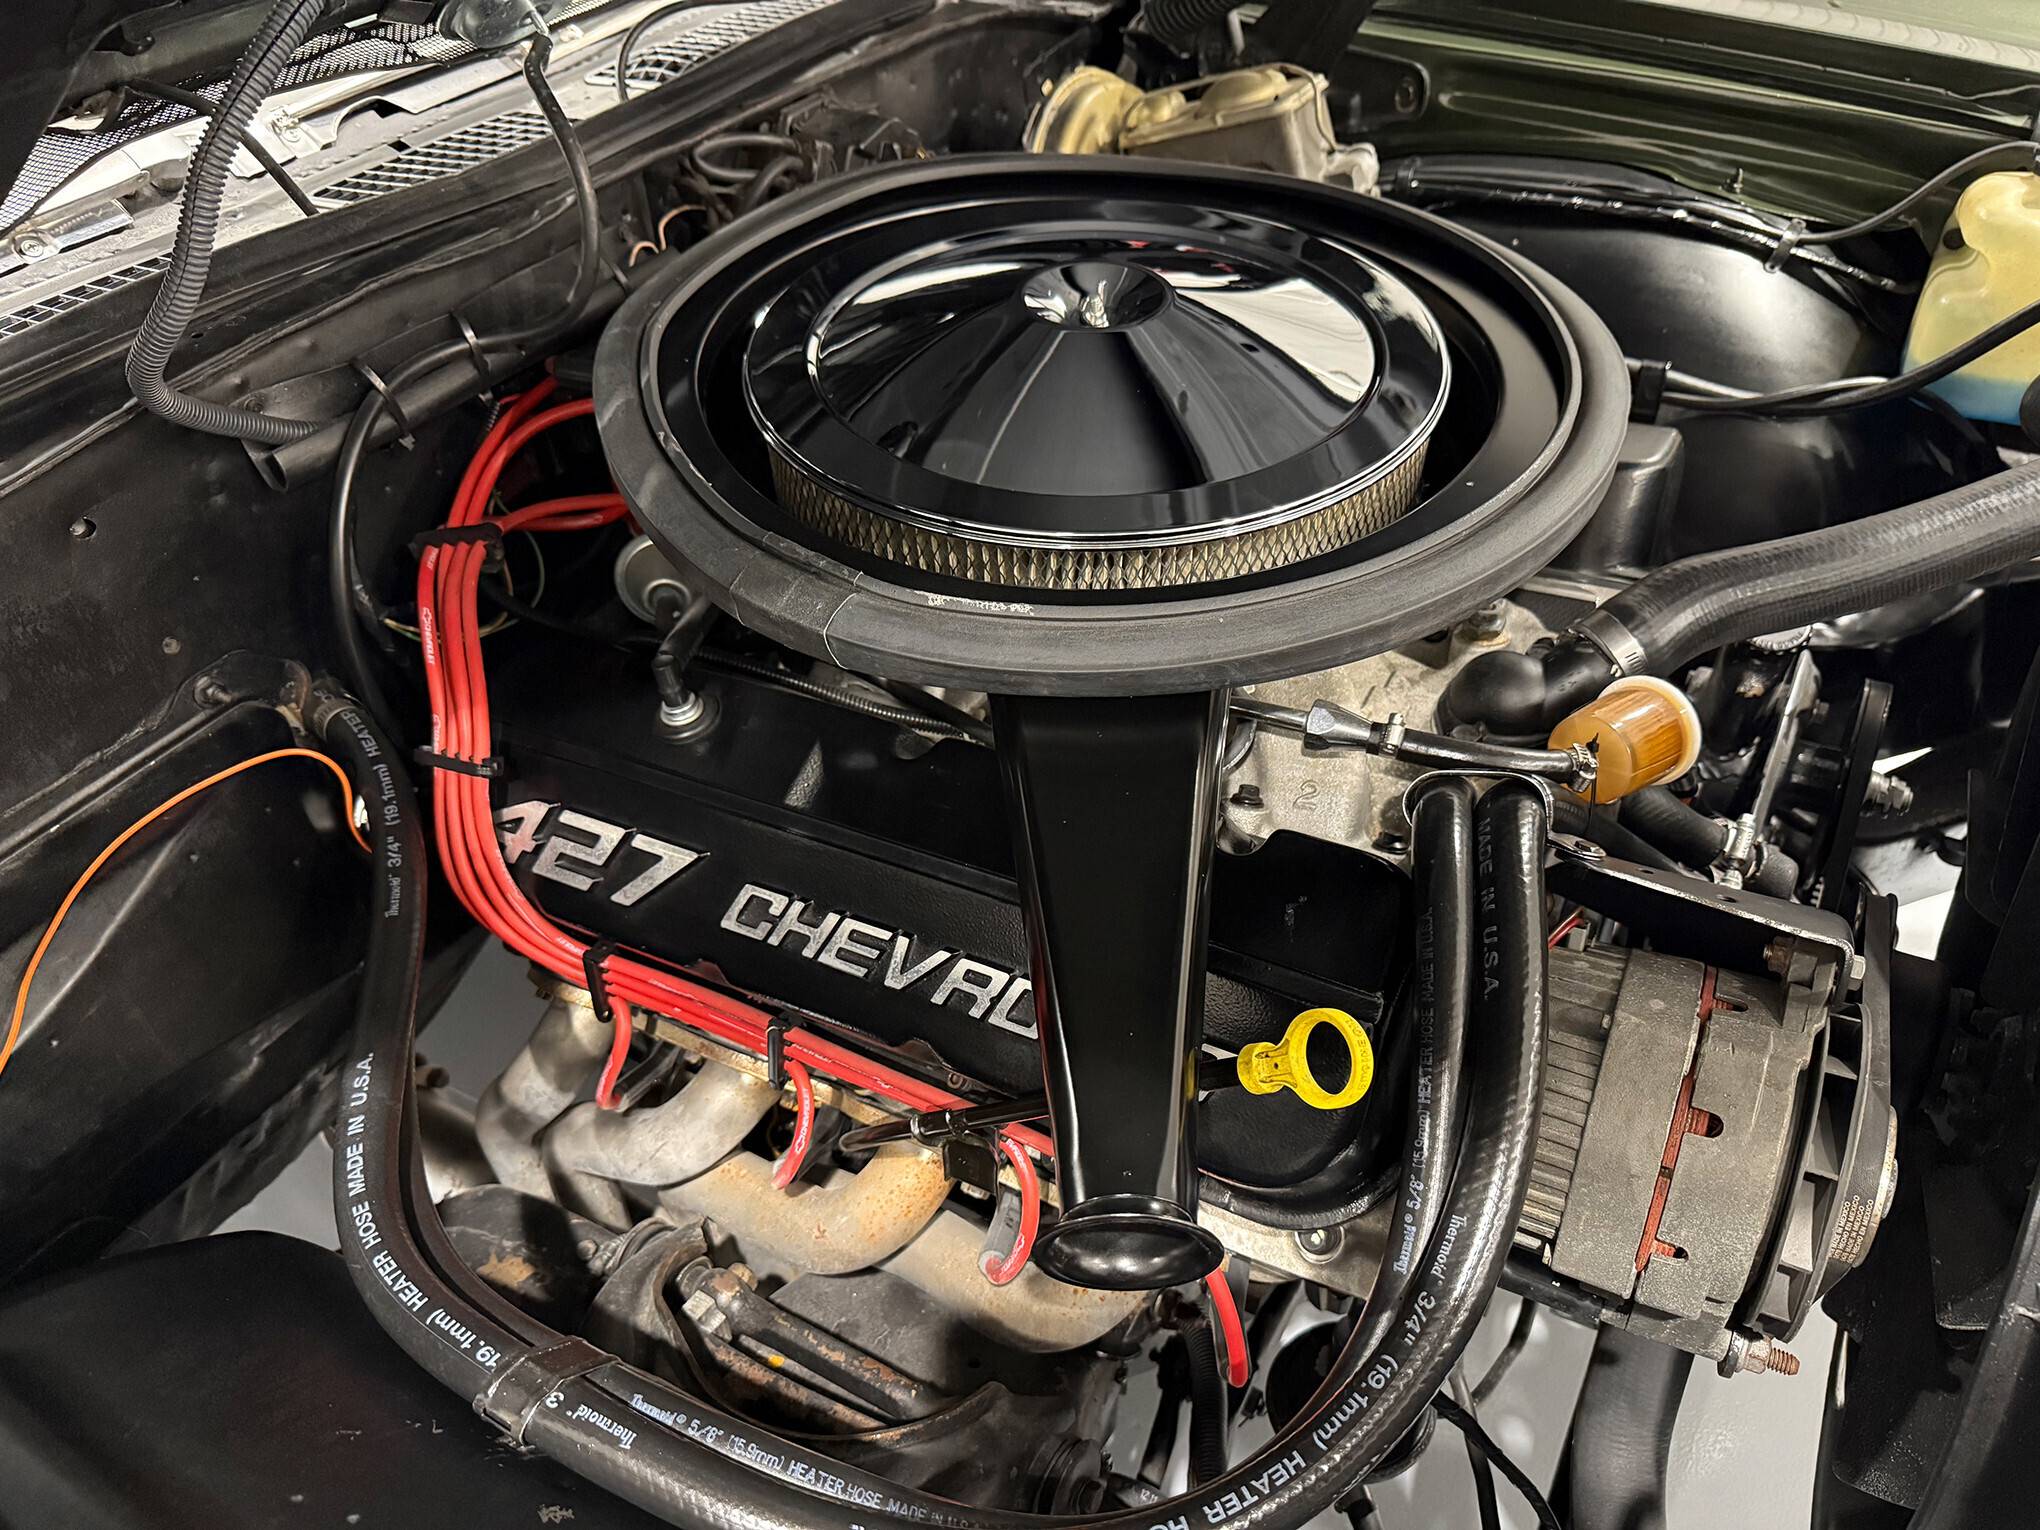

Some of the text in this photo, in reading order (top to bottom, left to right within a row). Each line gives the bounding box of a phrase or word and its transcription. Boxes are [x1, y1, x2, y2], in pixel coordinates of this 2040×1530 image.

[341, 710, 382, 758] HEATER
[372, 763, 401, 826] (19.1mm)
[386, 836, 402, 868] 3/4"
[494, 800, 706, 907] 427
[1420, 1007, 1434, 1044] HOSE
[351, 1052, 374, 1108] U.S.A.
[1417, 1046, 1433, 1104] HEATER
[347, 1114, 365, 1136] IN
[347, 1142, 366, 1198] MADE
[1408, 1175, 1424, 1211] 5/8"
[352, 1201, 382, 1250] HOSE
[1848, 1195, 1860, 1222] MEXICO
[1853, 1205, 1865, 1231] MEXICO
[1862, 1199, 1874, 1226] MEXICO
[1431, 1214, 1467, 1276] Thermoid
[372, 1250, 429, 1312] HEATER
[1404, 1291, 1436, 1346] 3/4"
[574, 1403, 638, 1450] Thermoid
[687, 1419, 724, 1444] 5/8"
[787, 1459, 845, 1498] HEATER
[846, 1483, 883, 1509] HOSE
[887, 1498, 928, 1519] MADE
[1203, 1450, 1306, 1524] HEATER
